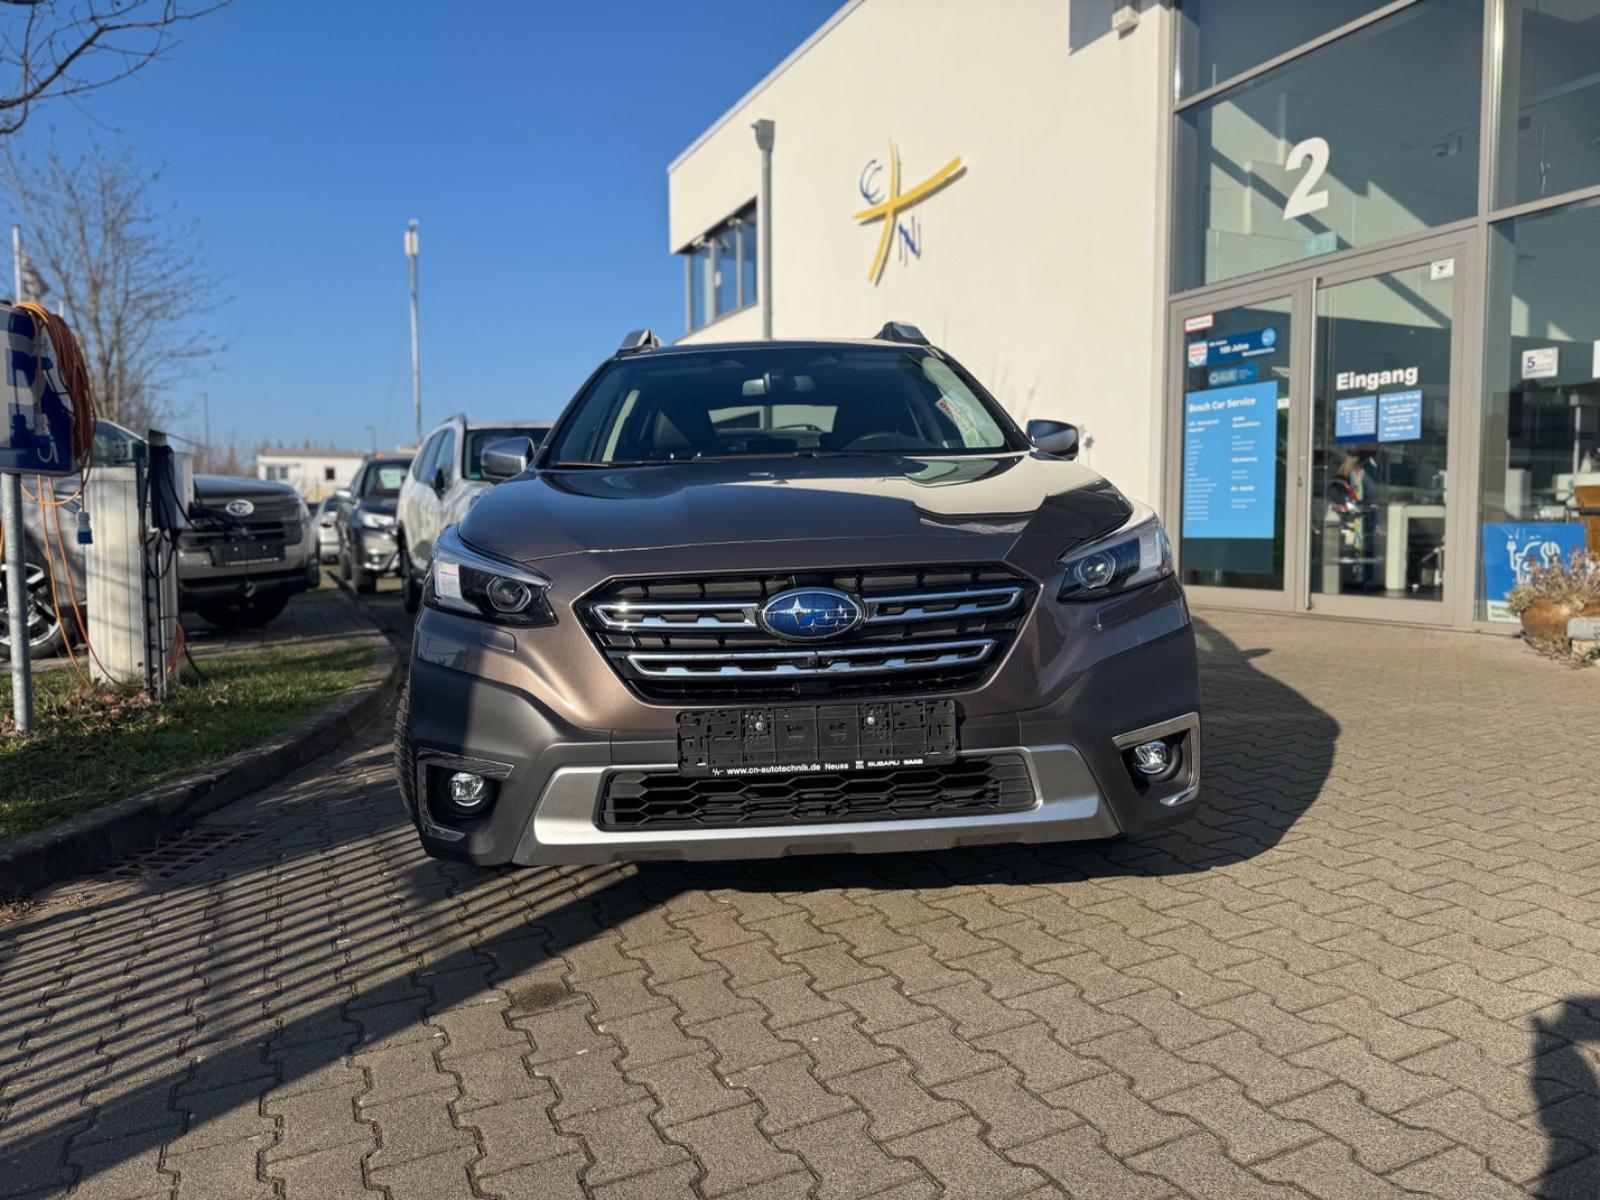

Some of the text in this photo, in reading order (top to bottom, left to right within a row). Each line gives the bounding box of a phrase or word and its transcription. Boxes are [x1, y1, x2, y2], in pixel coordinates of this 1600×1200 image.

[1283, 136, 1330, 221] 2
[898, 214, 921, 267] N
[1527, 356, 1536, 369] 5
[1336, 367, 1418, 391] Eingang
[1212, 400, 1225, 410] Car
[1227, 397, 1256, 408] Service
[727, 763, 820, 775] www.cn-autotechnik.de
